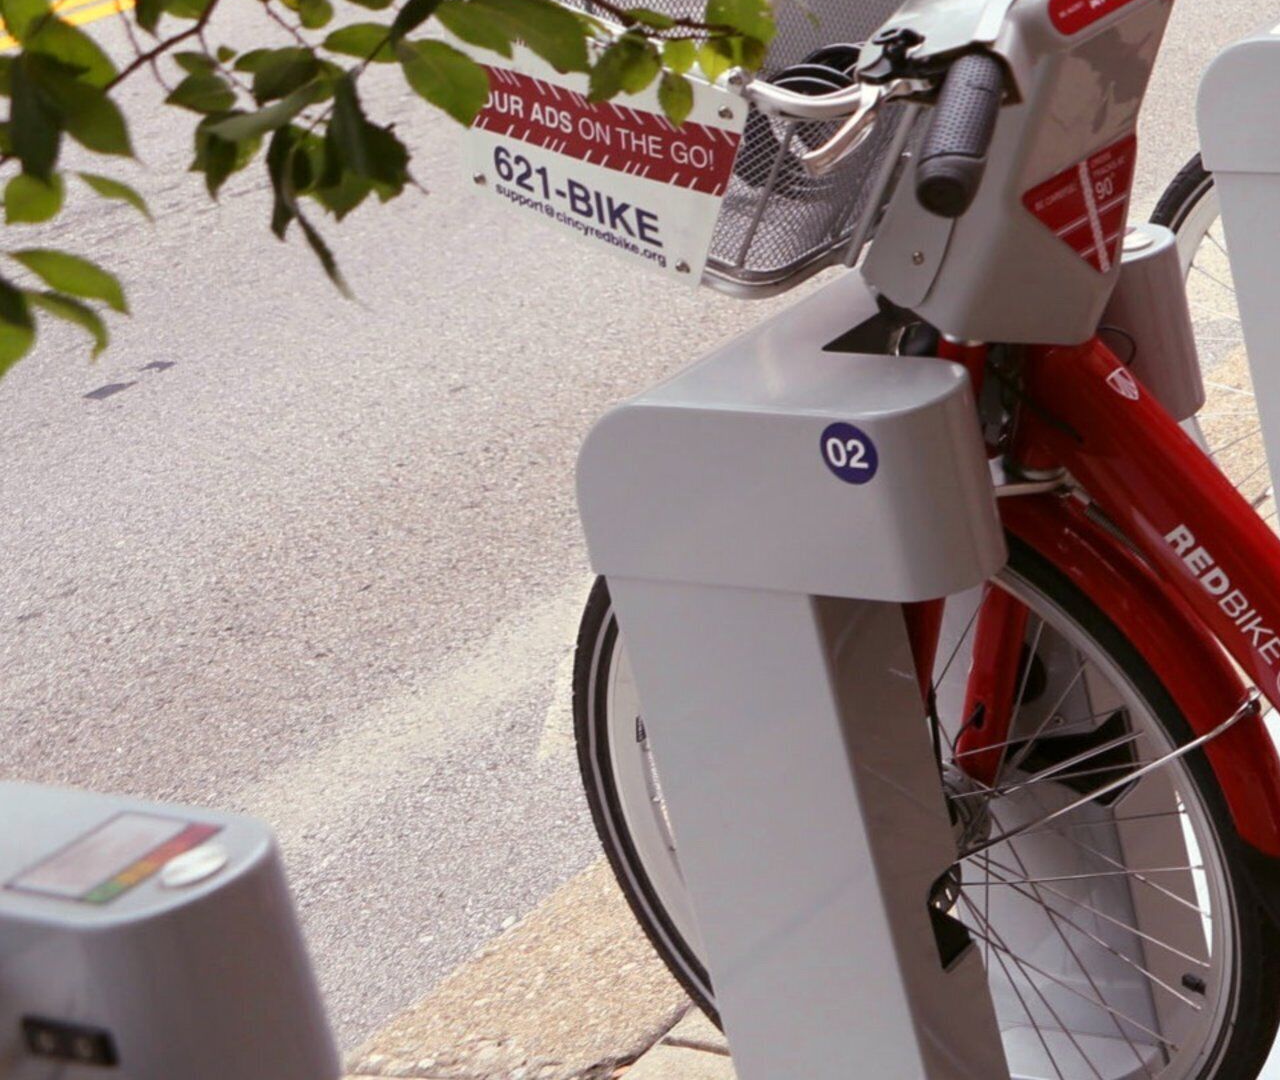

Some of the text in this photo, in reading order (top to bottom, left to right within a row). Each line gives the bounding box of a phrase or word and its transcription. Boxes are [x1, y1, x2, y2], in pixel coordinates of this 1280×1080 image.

[530, 102, 573, 134] ADS
[578, 116, 612, 146] ON
[616, 127, 664, 160] THE
[670, 141, 715, 171] GO!
[493, 145, 664, 248] 621-BIKE
[494, 183, 668, 269] support@cincyredbike.org
[826, 437, 869, 469] 02
